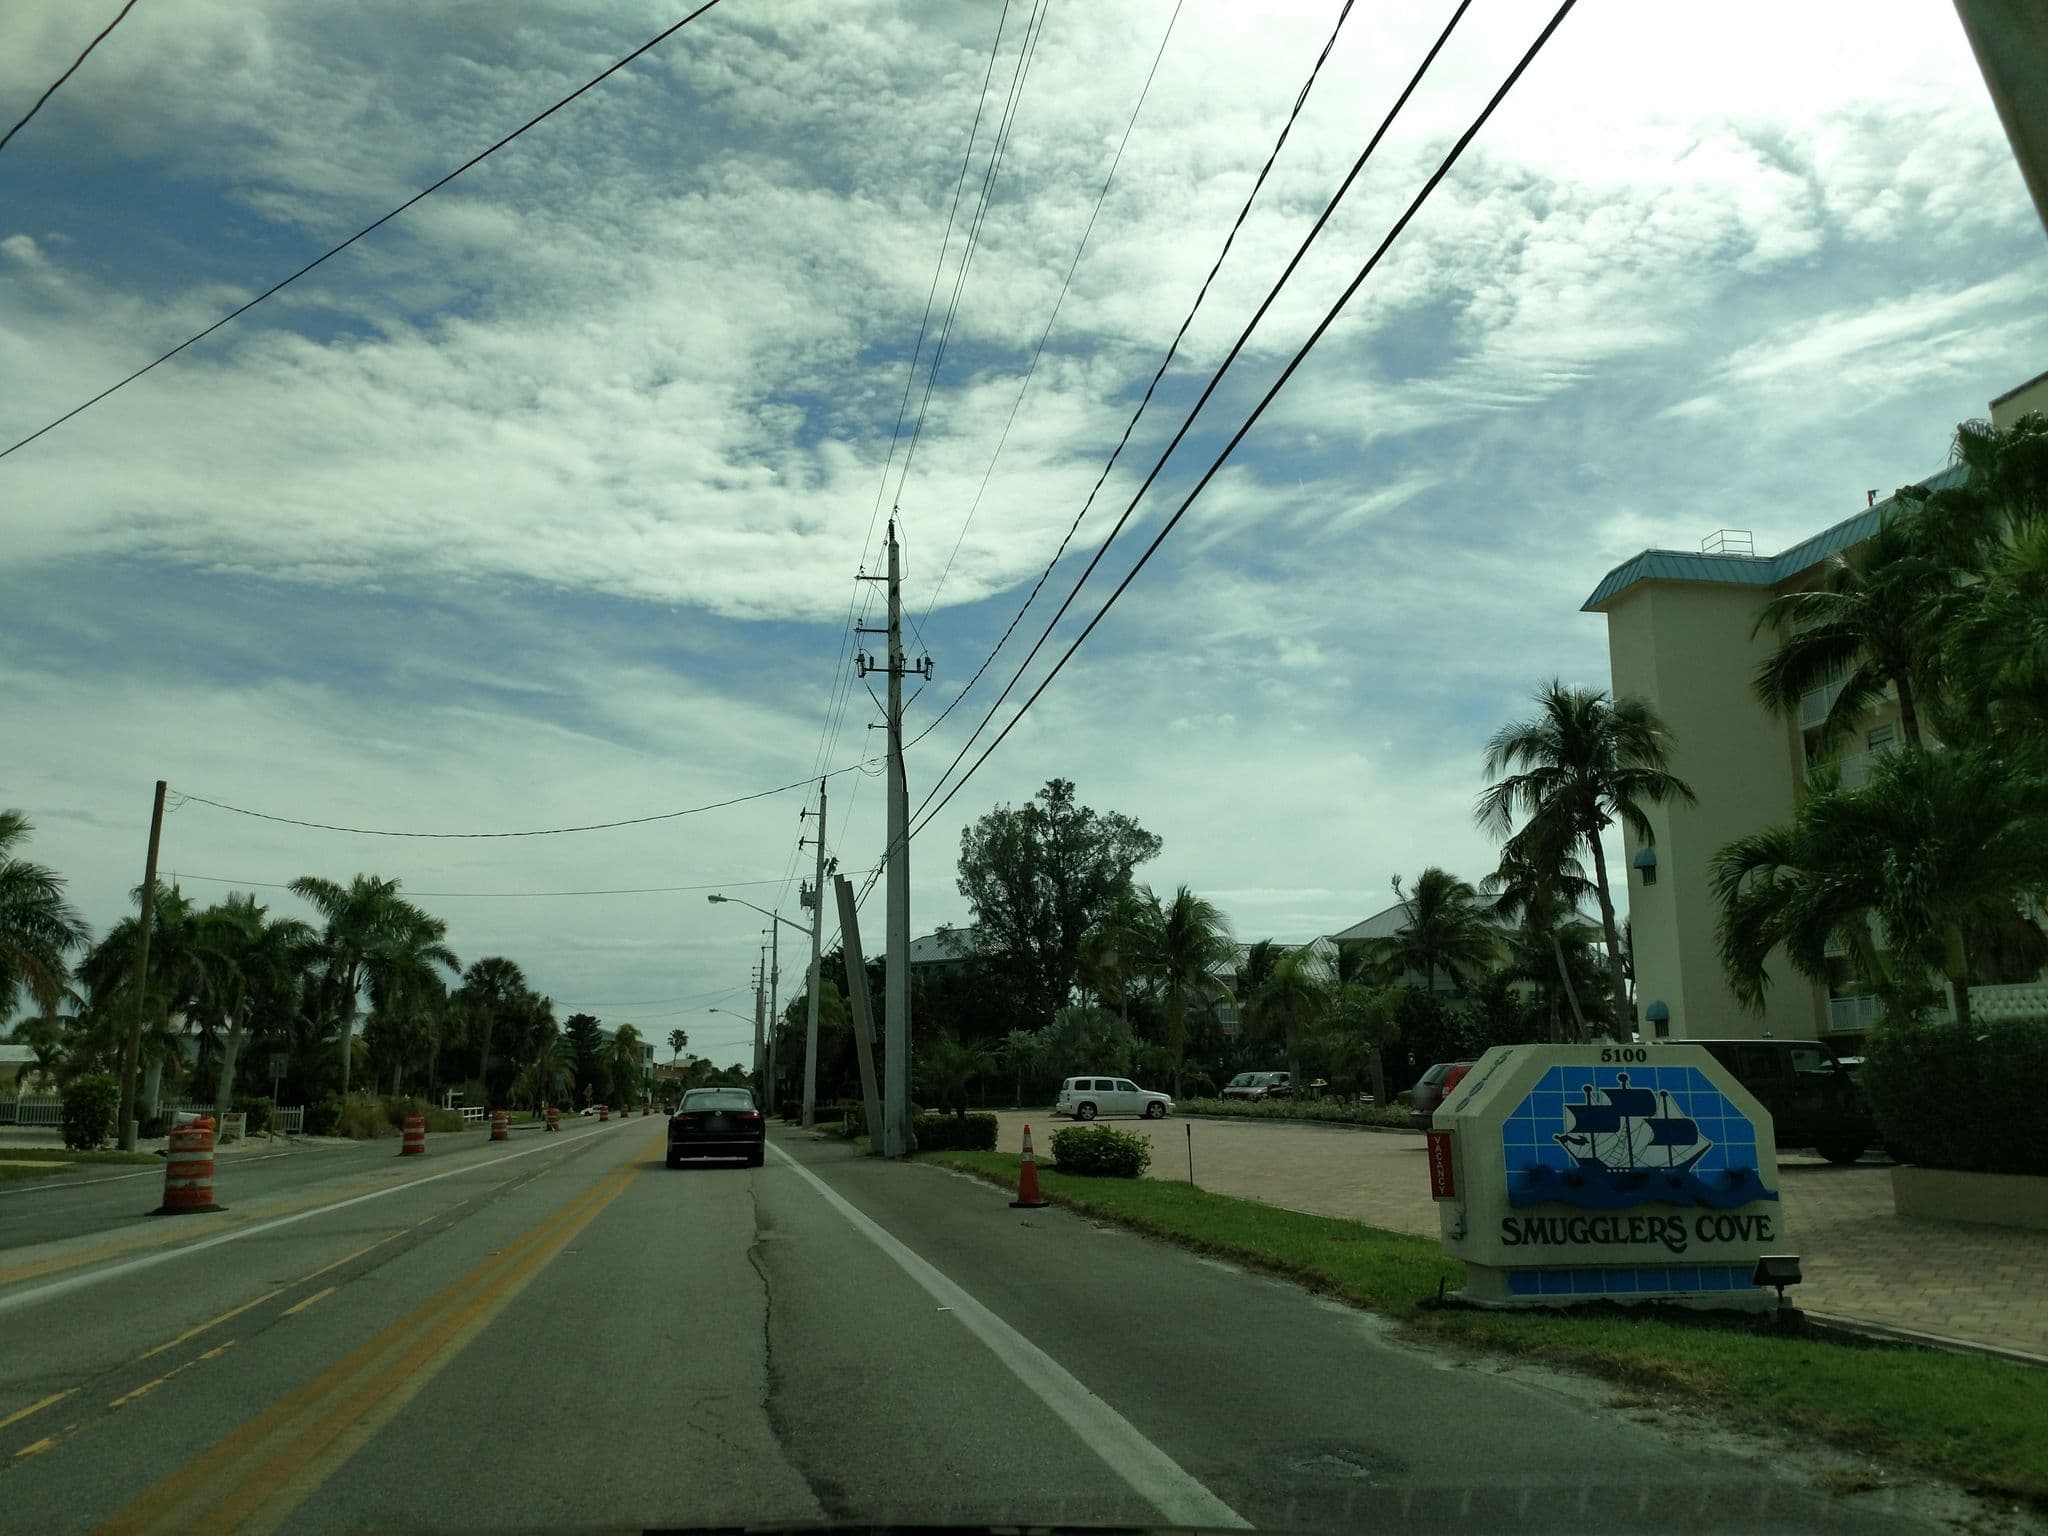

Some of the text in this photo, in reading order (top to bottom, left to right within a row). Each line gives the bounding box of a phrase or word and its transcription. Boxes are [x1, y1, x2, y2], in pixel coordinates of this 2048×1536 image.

[1601, 1048, 1647, 1063] 5100
[1434, 1136, 1446, 1194] VACANCY
[1501, 1214, 1776, 1253] SMUGGLERS COVE
